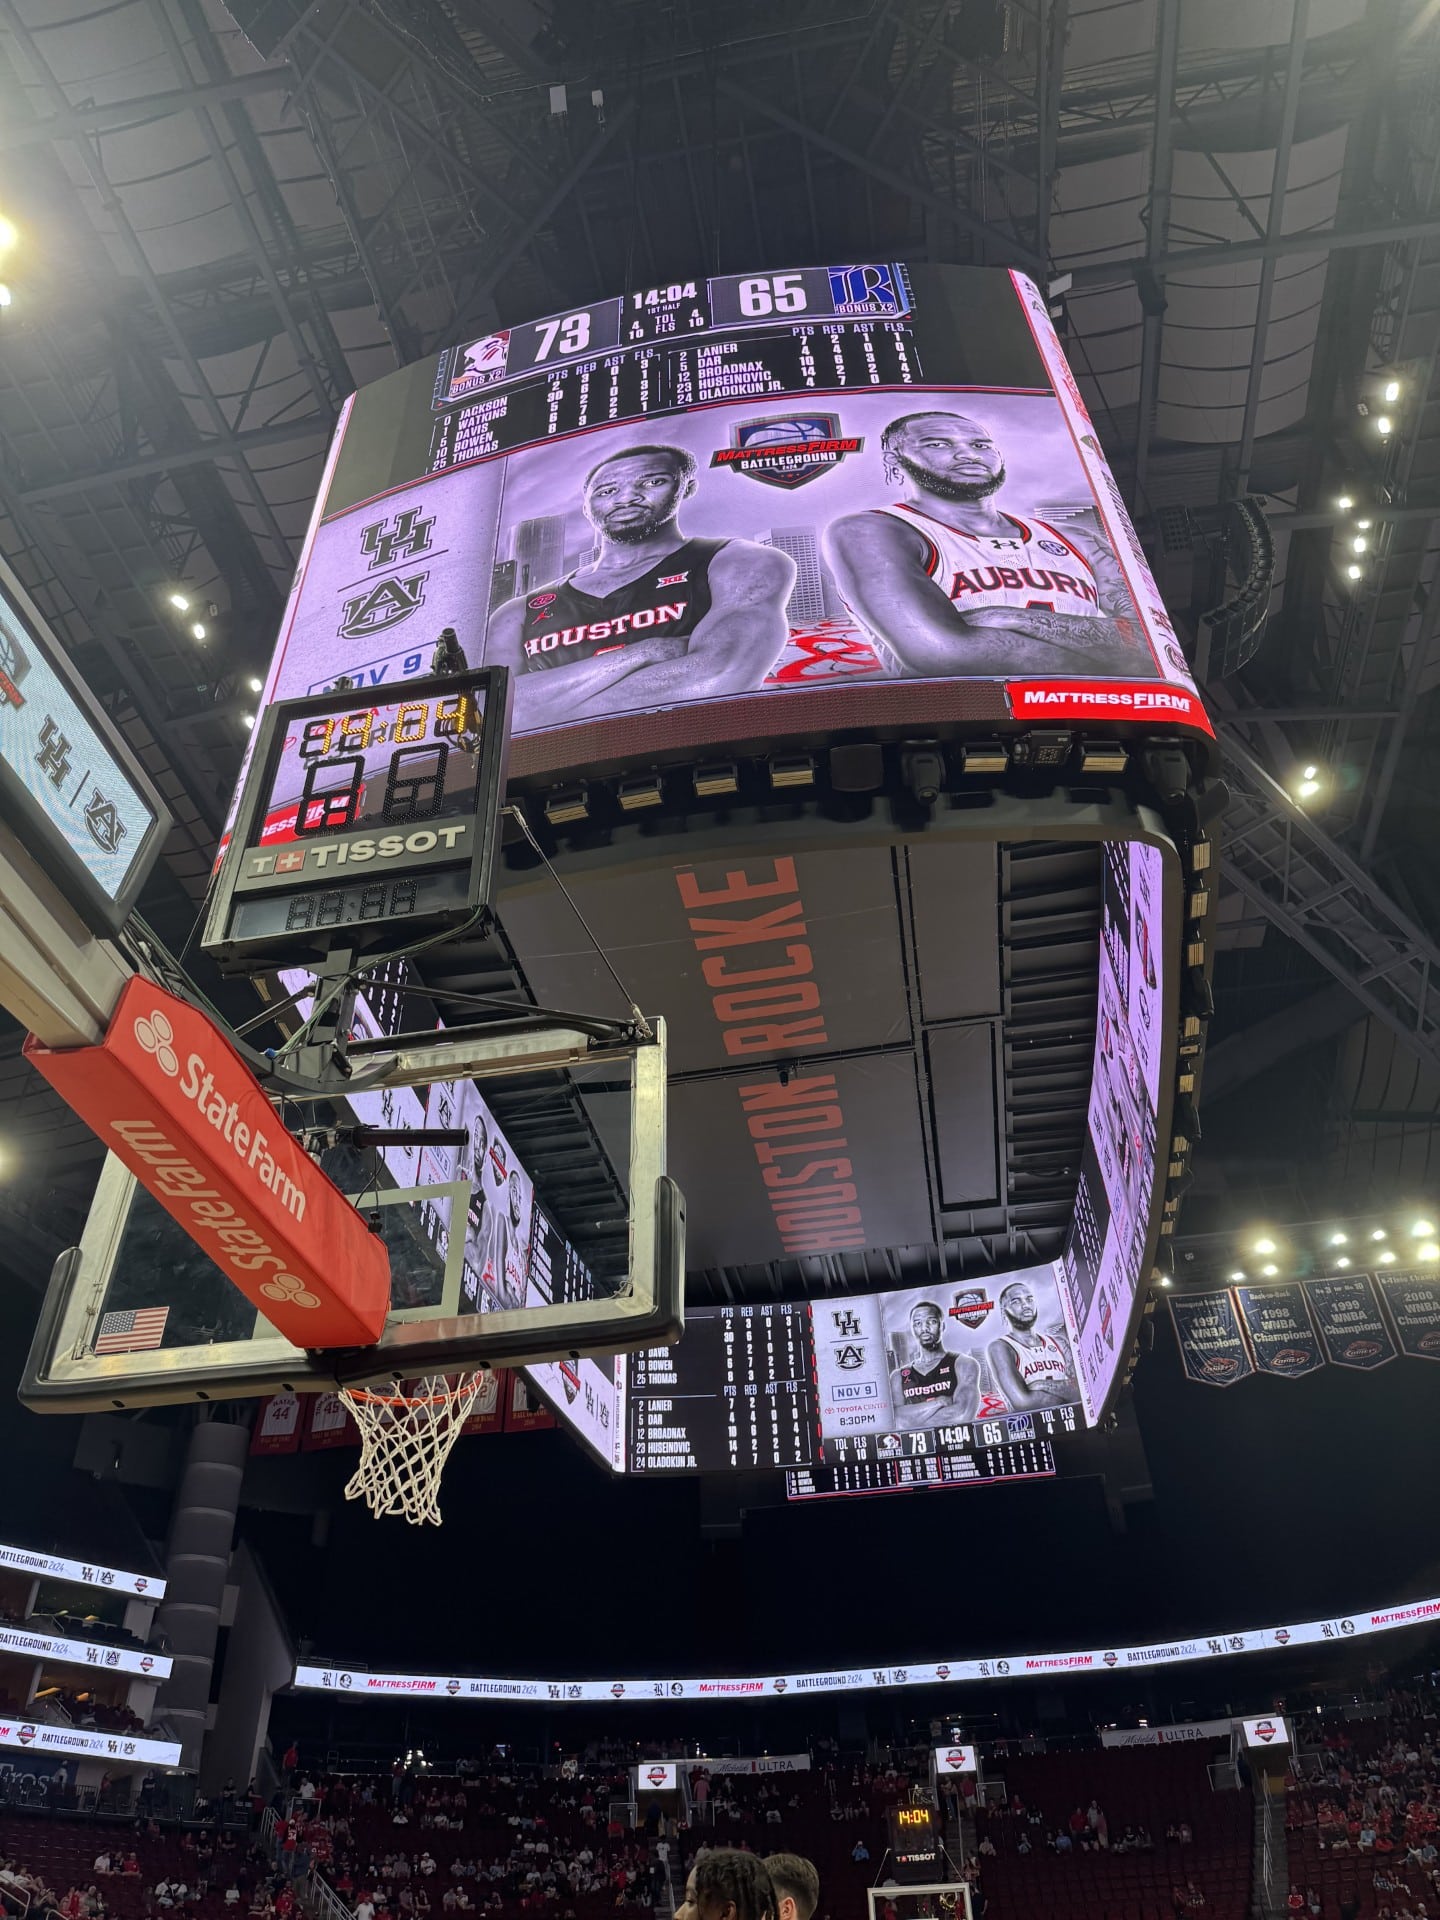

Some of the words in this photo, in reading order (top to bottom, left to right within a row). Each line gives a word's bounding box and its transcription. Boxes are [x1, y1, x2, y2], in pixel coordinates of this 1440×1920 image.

[633, 282, 697, 309] 14:04
[739, 274, 807, 316] 65
[662, 303, 680, 312] HALF
[692, 309, 699, 318] 4
[839, 304, 876, 313] BONUS
[632, 321, 640, 329] 4
[655, 313, 675, 325] TOL
[629, 329, 644, 340] 10
[656, 322, 675, 334] FLS
[688, 317, 704, 327] 10
[792, 326, 814, 336] PTS
[822, 324, 845, 334] REB
[854, 323, 874, 332] AST
[884, 322, 904, 332] FLS
[535, 312, 590, 362] 73
[680, 352, 687, 361] 2
[698, 344, 738, 358] LANIER
[800, 336, 807, 345] 7
[831, 334, 839, 343] 2
[863, 333, 869, 342] 1
[894, 332, 900, 340] 1
[680, 362, 687, 371] 5
[698, 356, 722, 368] DAR
[802, 346, 810, 355] 4
[864, 343, 873, 352] 0
[895, 342, 904, 352] 0
[548, 370, 568, 382] PTS
[576, 362, 596, 375] REB
[604, 355, 626, 368] AST
[634, 349, 654, 360] FLS
[678, 372, 690, 382] 12
[698, 361, 763, 379] BROADNAX
[799, 356, 814, 366] 10
[452, 375, 485, 394] BONUS
[488, 370, 502, 380] X2
[677, 382, 692, 393] 23
[699, 371, 772, 390] HUSEINOVIC
[801, 366, 816, 376] 14
[677, 393, 692, 404] 24
[700, 382, 764, 400] OLADOKUN
[768, 381, 784, 392] JR.
[806, 377, 815, 386] 4
[444, 416, 451, 426] 0
[459, 396, 508, 420] JACKSON
[444, 427, 448, 436] 1
[458, 407, 507, 430] WATKINS
[440, 437, 447, 447] 5
[456, 422, 488, 442] DAVIS
[436, 447, 448, 459] 10
[454, 431, 494, 452] BOWEN
[717, 439, 857, 462] MATTRESSFIRM
[432, 458, 446, 471] 25
[452, 440, 498, 464] THOMAS
[741, 452, 837, 469] BATTLEGROUND
[950, 565, 1097, 604] AUBURN
[523, 602, 688, 658] HOUSTON
[404, 654, 422, 675] 9
[1024, 690, 1190, 712] MATTRESSFIRM
[311, 826, 466, 868] TISSOT
[676, 856, 828, 1056] ROCKE
[738, 1074, 866, 1252] HOUSTON
[1404, 1291, 1434, 1302] 2000
[722, 1308, 734, 1318] PTS
[741, 1307, 753, 1317] REB
[760, 1306, 773, 1316] AST
[780, 1304, 792, 1314] FLS
[1262, 1308, 1290, 1320] 1998
[1332, 1300, 1360, 1312] 1999
[1192, 1316, 1220, 1328] 1997
[1331, 1310, 1368, 1323] WNBA
[1191, 1326, 1227, 1339] WNBA
[1260, 1319, 1298, 1331] WNBA
[1324, 1322, 1382, 1336] Champions
[1184, 1338, 1240, 1351] Champions
[1254, 1330, 1312, 1343] Champions
[648, 1346, 670, 1358] DAVIS
[638, 1360, 646, 1371] 10
[648, 1360, 672, 1371] BOWEN
[1024, 1360, 1066, 1378] AUBURN
[636, 1374, 646, 1384] 25
[648, 1372, 678, 1384] THOMAS
[724, 1386, 736, 1396] PTS
[744, 1384, 758, 1396] REB
[765, 1382, 778, 1394] AST
[786, 1382, 798, 1393] FLS
[838, 1386, 862, 1398] NOV
[865, 1386, 872, 1395] 9
[904, 1381, 950, 1398] HOUSTON
[272, 1408, 289, 1420] 44
[324, 1402, 340, 1414] 45
[638, 1400, 644, 1412] 2
[648, 1400, 672, 1412] LANIER
[836, 1405, 862, 1414] TOYOTA
[864, 1402, 888, 1412] CENTER
[638, 1414, 644, 1426] 5
[648, 1414, 663, 1425] DAR
[840, 1414, 876, 1426] 8:30PM
[1040, 1410, 1056, 1423] TOL
[1060, 1406, 1074, 1419] FLS
[637, 1428, 645, 1440] 12
[648, 1428, 686, 1440] BROADNAX
[983, 1422, 1002, 1444] 65
[1048, 1422, 1054, 1434] 4
[1064, 1418, 1076, 1431] 10
[834, 1438, 848, 1450] TOL
[854, 1436, 867, 1449] FLS
[908, 1432, 926, 1454] 73
[938, 1428, 970, 1445] 14:04
[636, 1442, 646, 1454] 23
[648, 1441, 690, 1454] HUSEINOVIC
[728, 1440, 738, 1452] 14
[840, 1450, 846, 1462] 4
[856, 1448, 867, 1461] 10
[636, 1456, 646, 1468] 24
[648, 1456, 686, 1468] OLADOKUN
[1371, 1603, 1440, 1626] MATTRESSFIRM
[1026, 1656, 1093, 1669] MATTRESSFIRM
[1128, 1646, 1180, 1662] BATTLEGROUND
[367, 1678, 436, 1691] MATTRESSFIRM
[470, 1682, 521, 1694] BATTLEGROUND
[699, 1682, 764, 1694] MATTRESSFIRM
[796, 1675, 846, 1688] BATTLEGROUND
[42, 1732, 89, 1748] BATTLEGROUND
[1165, 1728, 1204, 1741] ULTRA
[758, 1760, 794, 1772] ULTRA
[0, 1763, 58, 1797] Fros
[898, 1808, 930, 1825] 14:04
[906, 1853, 936, 1862] TISSOT
